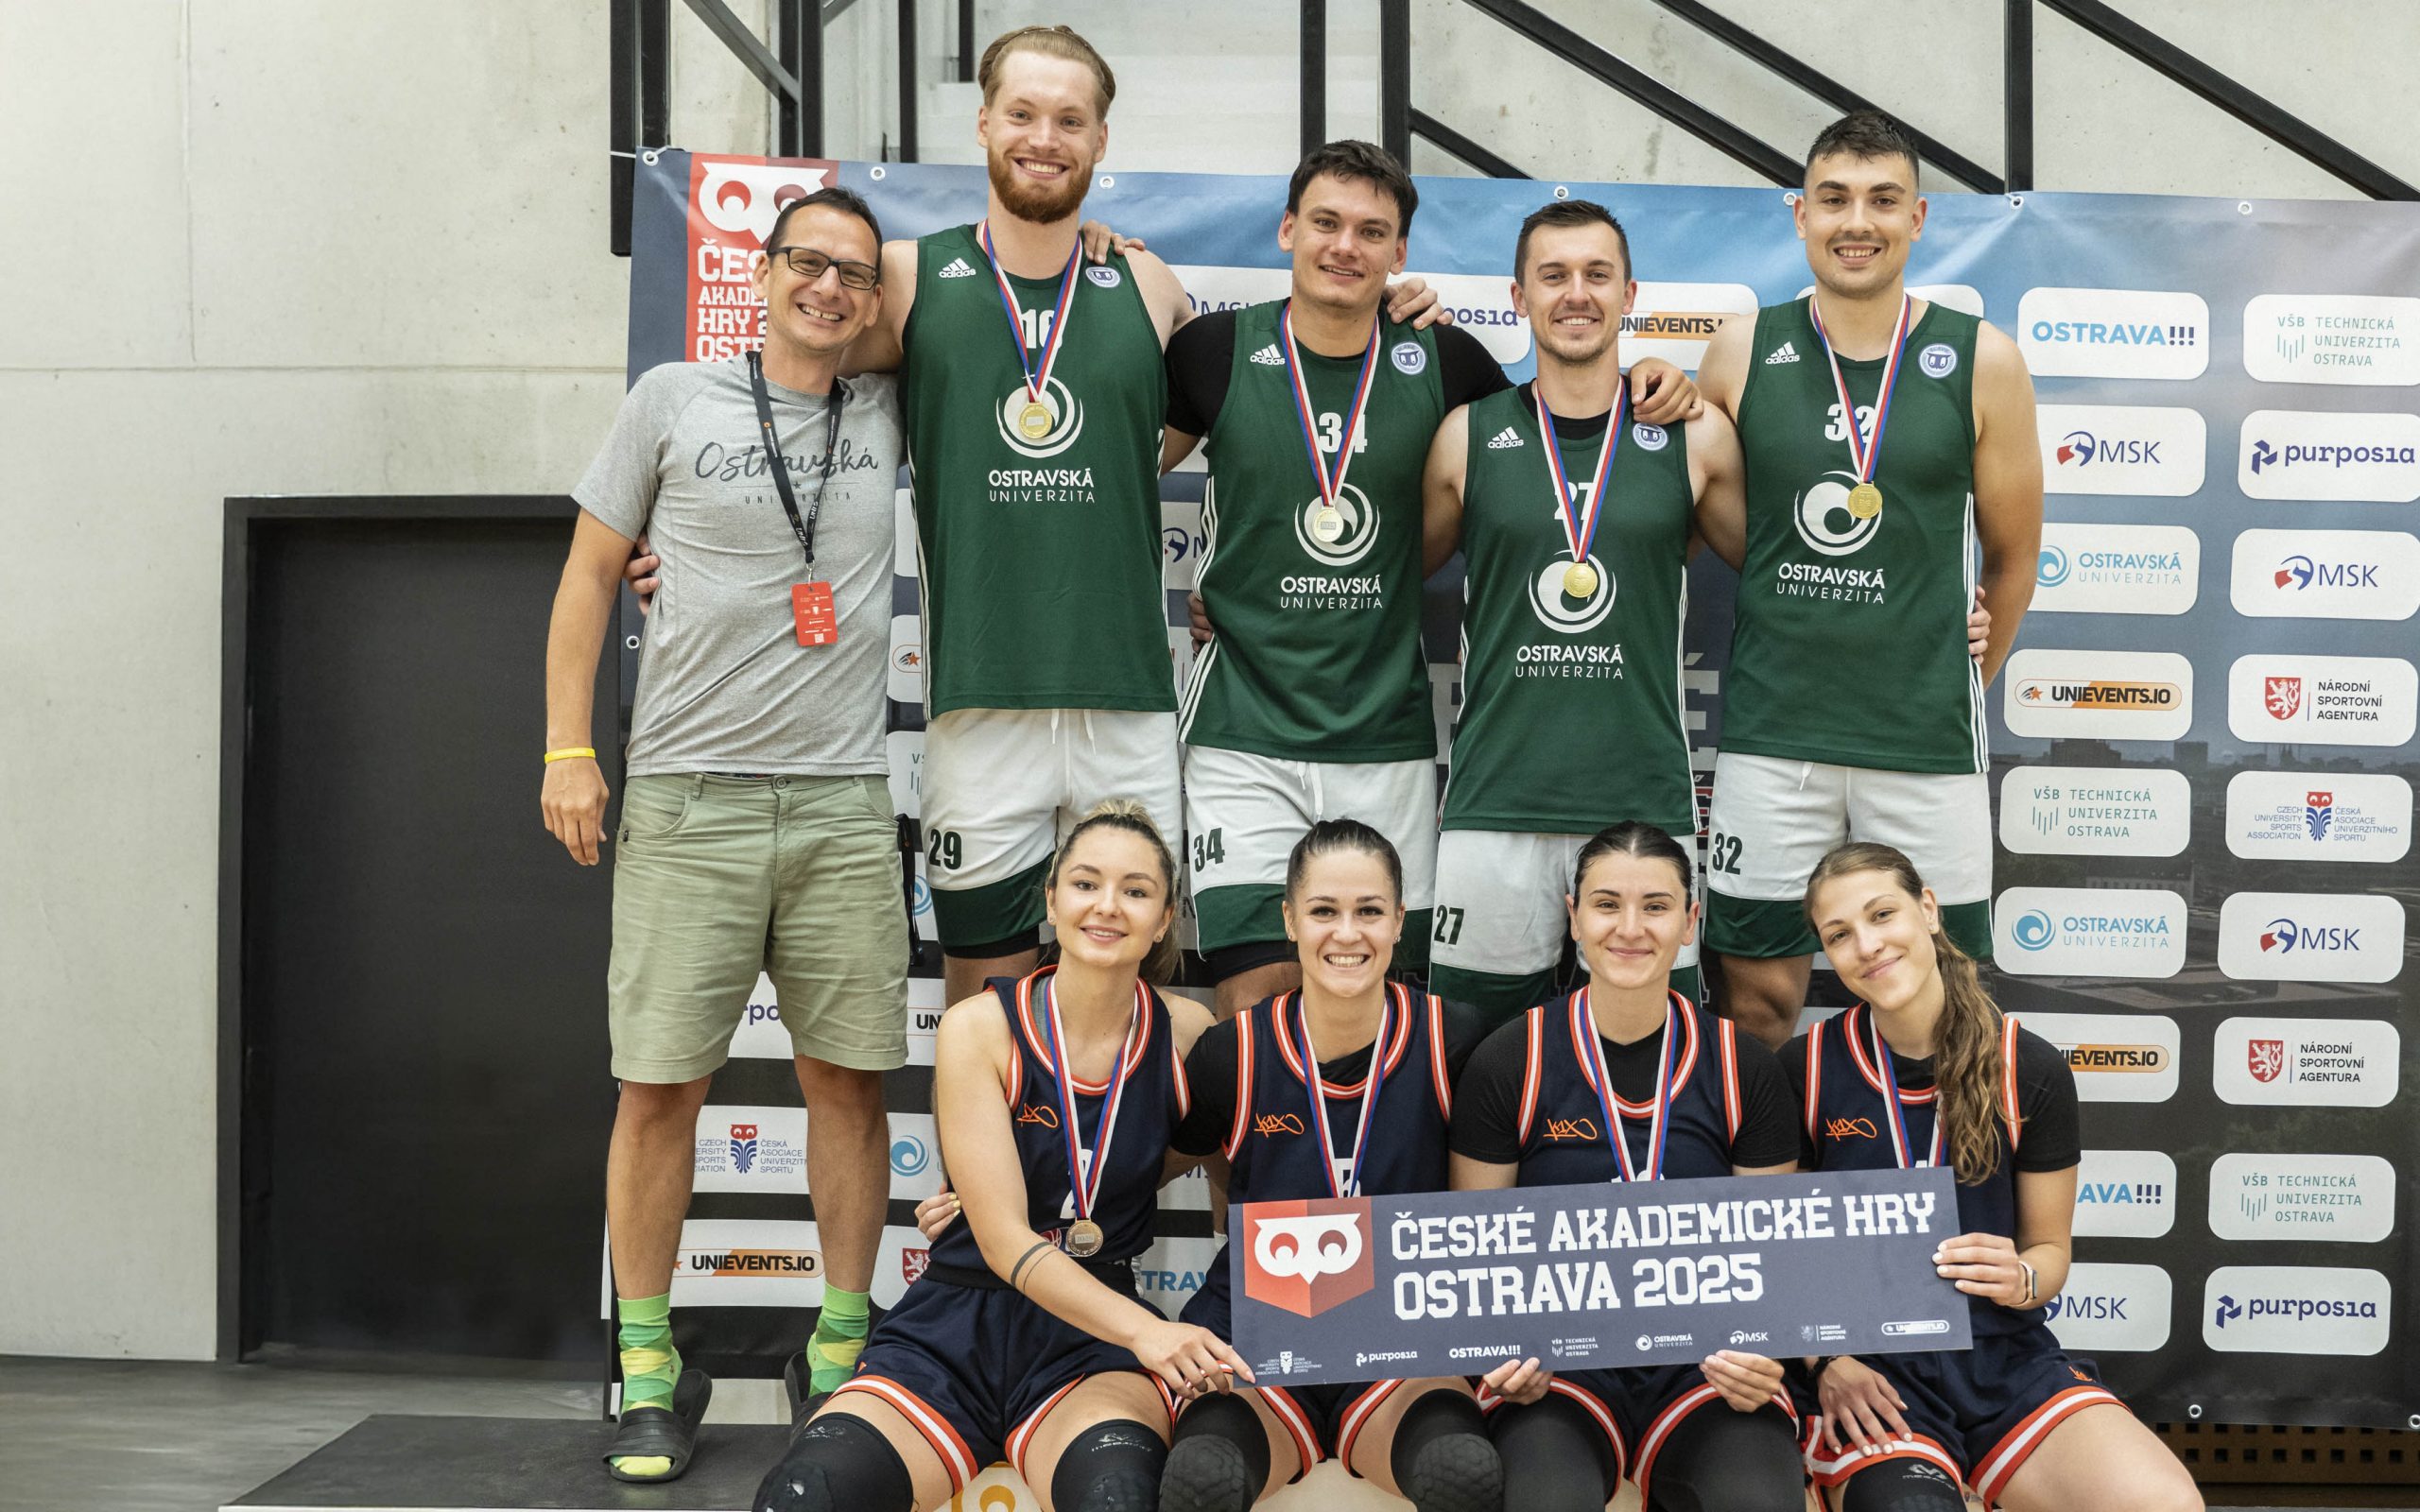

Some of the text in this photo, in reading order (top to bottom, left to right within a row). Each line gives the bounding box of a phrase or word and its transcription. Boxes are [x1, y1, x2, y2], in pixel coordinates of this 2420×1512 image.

[939, 266, 977, 278] adidas
[697, 308, 751, 335] HRY
[2277, 315, 2394, 331] VŠB TECHNICKÁ
[2031, 319, 2195, 347] OSTRAVA!!!
[2314, 335, 2400, 350] UNIVERZITA
[1250, 353, 1286, 366] adidas
[1765, 352, 1800, 365] adidas
[2313, 352, 2373, 367] OSTRAVA
[1824, 403, 1876, 444] 32
[1319, 412, 1368, 454] 34
[1488, 438, 1524, 449] adidas
[2100, 439, 2162, 464] MSK
[2284, 443, 2415, 469] purposia
[988, 467, 1095, 488] OSTRAVSKÁ
[989, 490, 1095, 503] UNIVERZITA
[2079, 551, 2182, 571] OSTRAVSKÁ
[1778, 562, 1886, 590] OSTRAVSKÁ
[2079, 572, 2182, 585] UNIVERZITA
[2318, 564, 2378, 588] MSK
[1280, 574, 1381, 594] OSTRAVSKÁ
[1776, 582, 1884, 604] UNIVERZITA
[1280, 596, 1383, 610] UNIVERZITA
[1516, 644, 1623, 664] OSTRAVSKÁ
[1515, 664, 1623, 679] UNIVERZITA
[2318, 679, 2371, 694] NÁRODNÍ
[2051, 685, 2171, 705] UNIEVENTS.IO
[2317, 694, 2382, 709] SPORTOVNÍ
[2316, 710, 2378, 722] AGENTURA
[2033, 786, 2152, 802] VŠB TECHNICKÁ
[2068, 807, 2157, 821] UNIVERZITA
[2335, 806, 2361, 816] ČESKÁ
[2334, 816, 2376, 825] ASOCIACE
[2067, 825, 2130, 838] OSTRAVA
[2247, 832, 2301, 840] ASSOCIATION
[2334, 825, 2398, 834] UNIVERZITNÍHO
[2334, 833, 2366, 842] SPORTU
[928, 828, 962, 870] 29
[1194, 827, 1225, 872] 34
[1712, 832, 1743, 875] 32
[1434, 904, 1465, 945] 27
[2063, 915, 2169, 935] OSTRAVSKÁ
[2063, 936, 2169, 949] UNIVERZITA
[2301, 927, 2360, 951] MSK
[2300, 1042, 2352, 1055] NÁRODNÍ
[2300, 1056, 2364, 1070] SPORTOVNÍ
[2299, 1072, 2360, 1084] AGENTURA
[760, 1139, 787, 1147] ČESKÁ
[2242, 1173, 2357, 1188] VŠB TECHNICKÁ
[2077, 1183, 2162, 1204] AVA!!!
[2276, 1193, 2362, 1207] UNIVERZITA
[1392, 1189, 1935, 1261] ČESKÉ AKADEMICKÉ HRY
[2275, 1211, 2335, 1224] OSTRAVA
[692, 1255, 815, 1272] UNIEVENTS.IO
[1393, 1253, 1764, 1320] OSTRAVA 2025
[2066, 1296, 2127, 1320] MSK
[2249, 1296, 2377, 1320] purposia
[1653, 1333, 1692, 1343] OSTRAVSKÁ
[1745, 1332, 1769, 1342] MSK
[1369, 1349, 1418, 1364] purposia
[1448, 1344, 1521, 1359] OSTRAVA!!!
